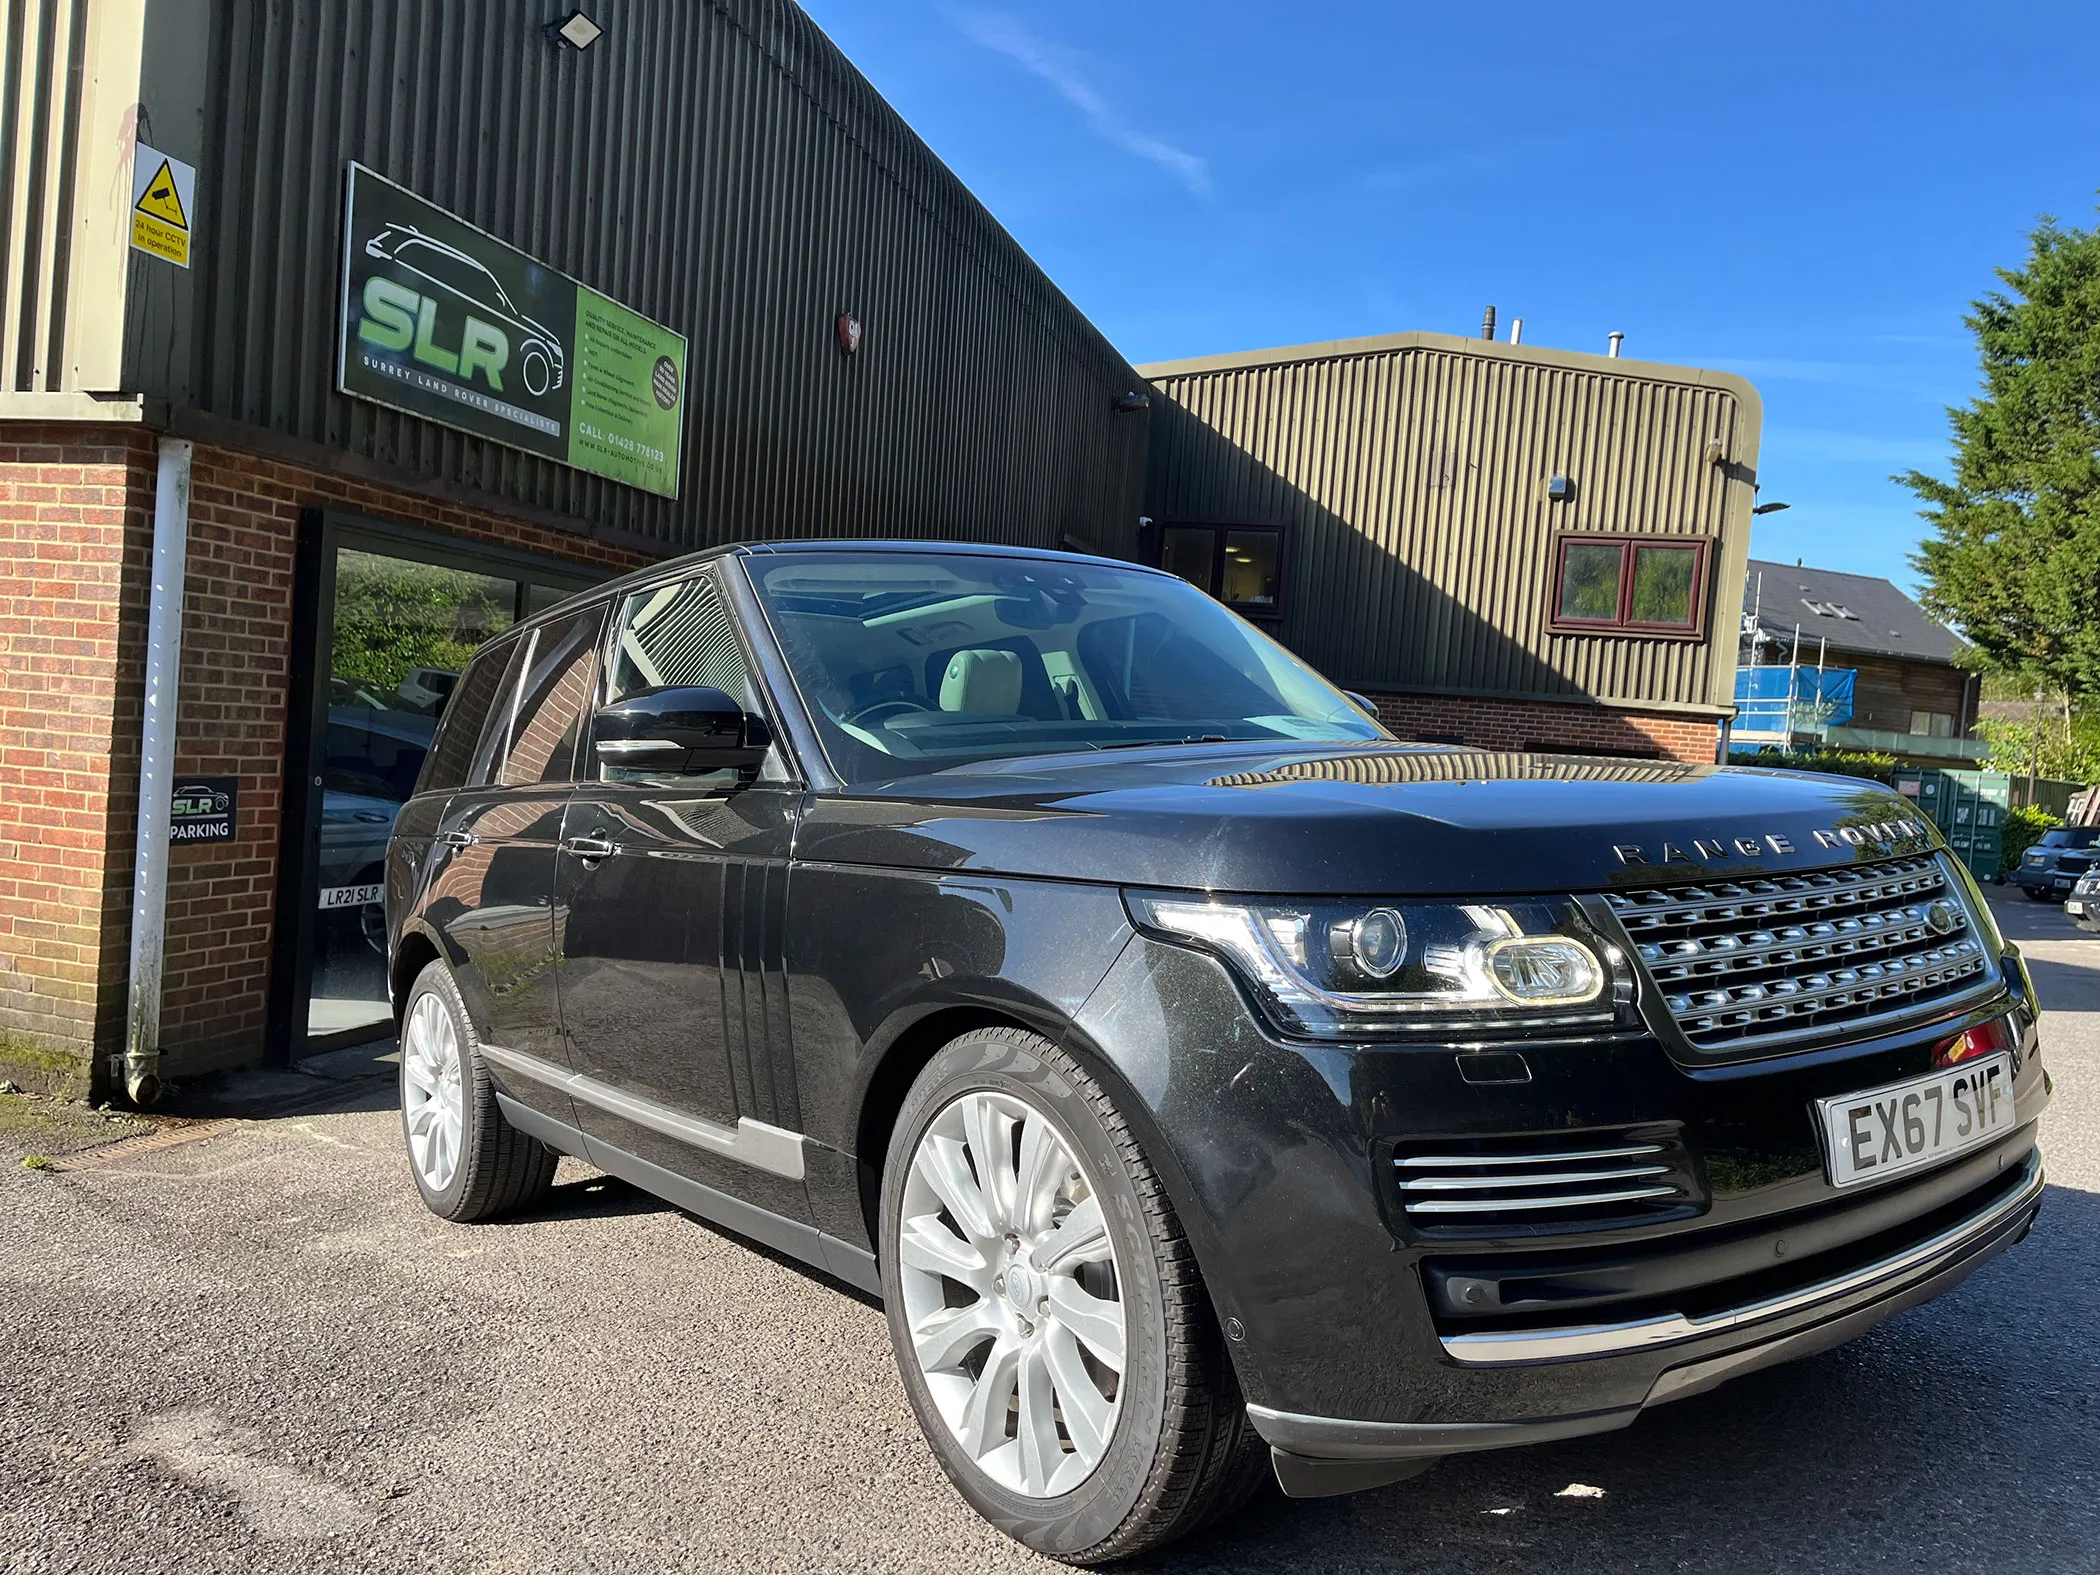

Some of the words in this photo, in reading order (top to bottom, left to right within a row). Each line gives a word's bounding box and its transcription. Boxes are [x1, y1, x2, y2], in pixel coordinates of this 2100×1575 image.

[135, 219, 145, 230] 24
[146, 222, 163, 238] hour
[165, 232, 186, 247] CCTV
[137, 233, 146, 243] in
[147, 236, 182, 257] operation
[358, 275, 510, 392] SLR
[363, 355, 411, 381] SURREY
[418, 375, 448, 393] LAND
[454, 388, 488, 409] ROVER
[494, 400, 557, 433] SPECIALISTS
[579, 421, 605, 442] CALL:
[608, 432, 634, 453] 01428
[171, 798, 212, 815] SLR
[170, 822, 229, 840] PARKING
[1612, 833, 1796, 866] RANGE
[1812, 818, 1927, 849] ROVER
[327, 889, 355, 907] LR21
[356, 887, 379, 902] SLR
[1848, 1084, 1944, 1172] EX67
[1952, 1064, 2001, 1137] SVF
